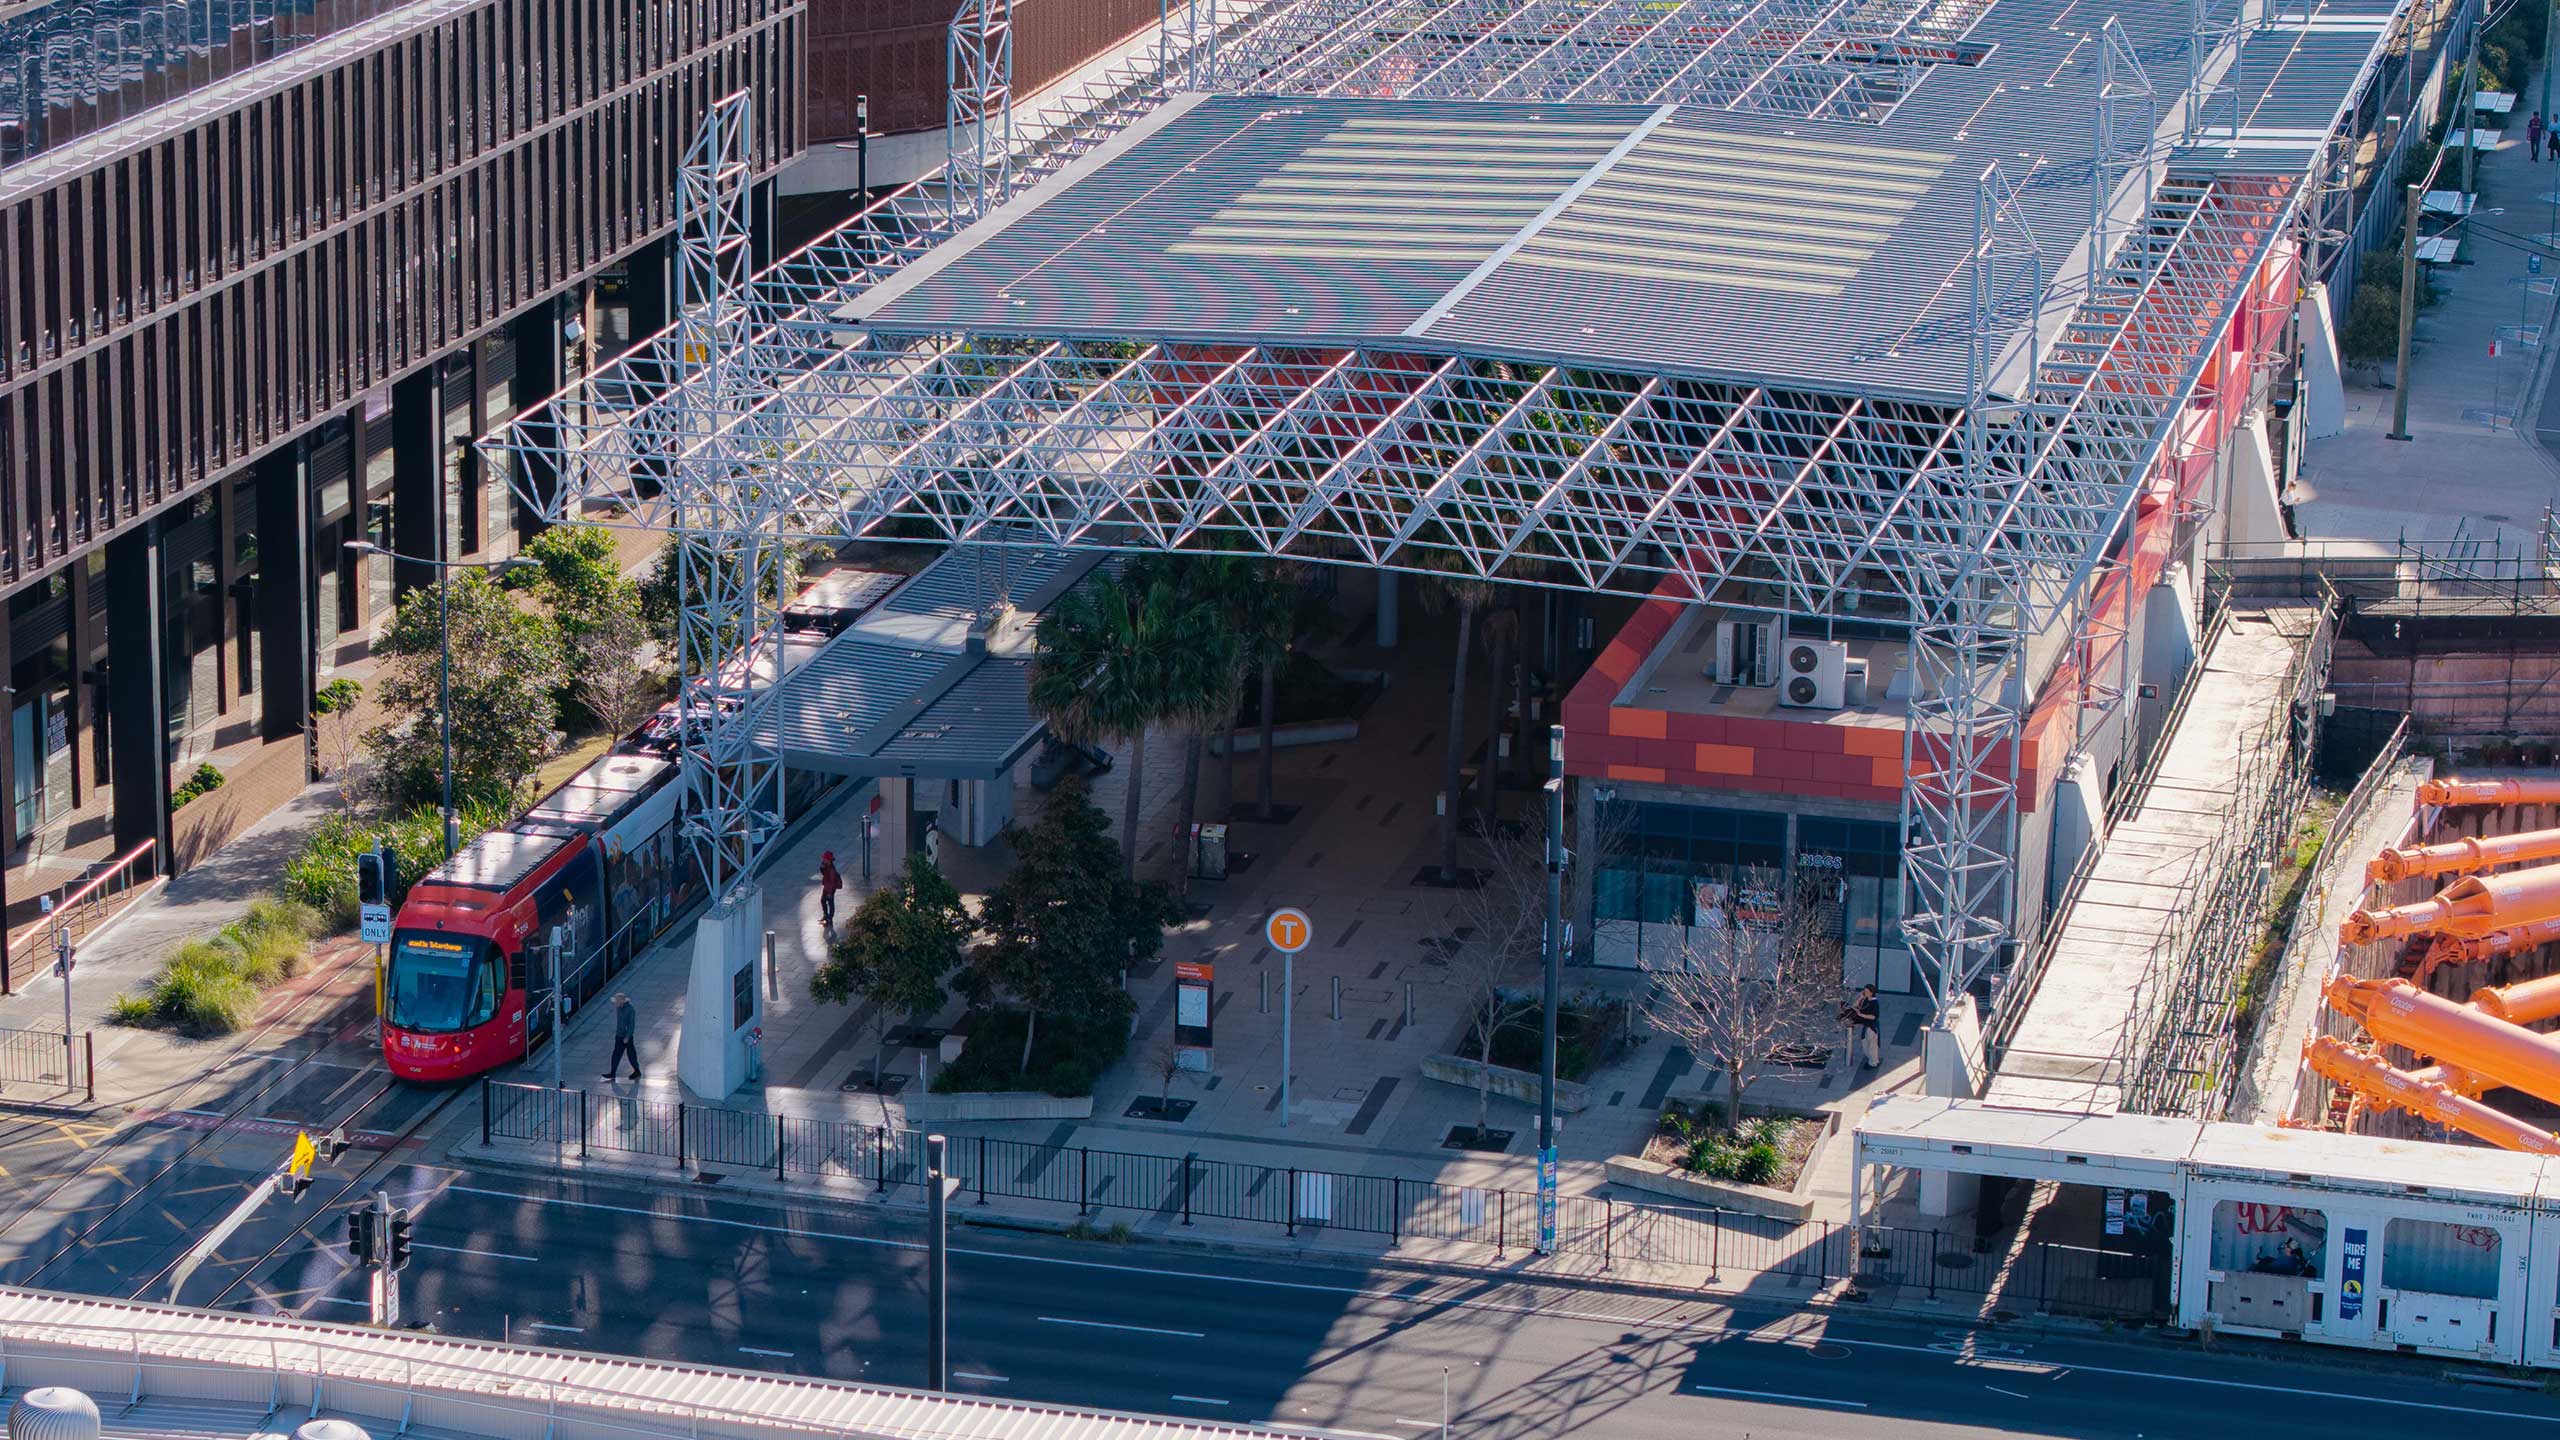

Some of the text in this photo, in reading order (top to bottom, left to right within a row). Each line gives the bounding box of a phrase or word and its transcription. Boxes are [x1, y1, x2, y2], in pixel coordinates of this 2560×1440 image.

[365, 927, 387, 938] ONLY
[1280, 920, 1298, 945] T
[2390, 996, 2416, 1012] Coates
[2383, 1074, 2408, 1090] Coates
[2437, 1099, 2461, 1115] Coates
[2518, 1133, 2544, 1150] Coates
[2344, 1242, 2366, 1256] HIRE
[2347, 1257, 2361, 1270] ME
